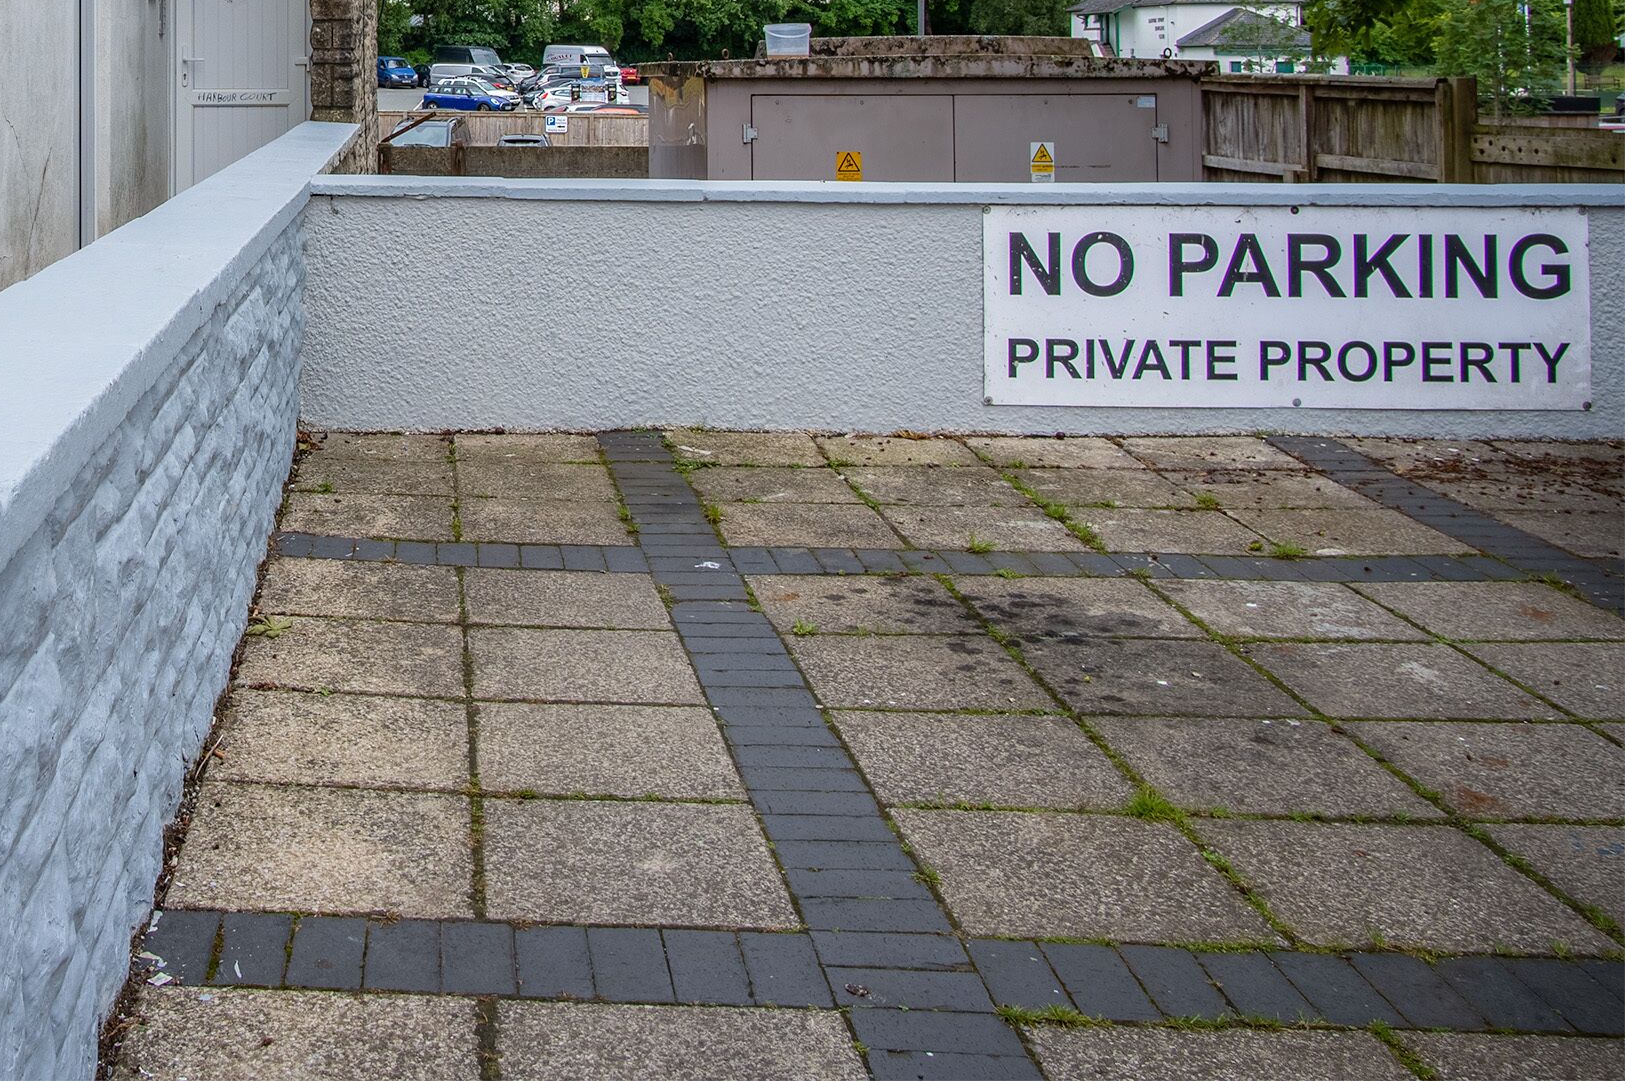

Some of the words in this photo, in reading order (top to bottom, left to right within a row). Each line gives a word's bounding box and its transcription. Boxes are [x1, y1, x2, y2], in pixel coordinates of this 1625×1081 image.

[197, 92, 237, 103] HARBOUR
[239, 91, 278, 102] COURT
[1008, 231, 1135, 296] NO
[1169, 232, 1573, 300] PARKING
[1007, 338, 1238, 381] PRIVATE
[1259, 341, 1571, 383] PROPERTY
